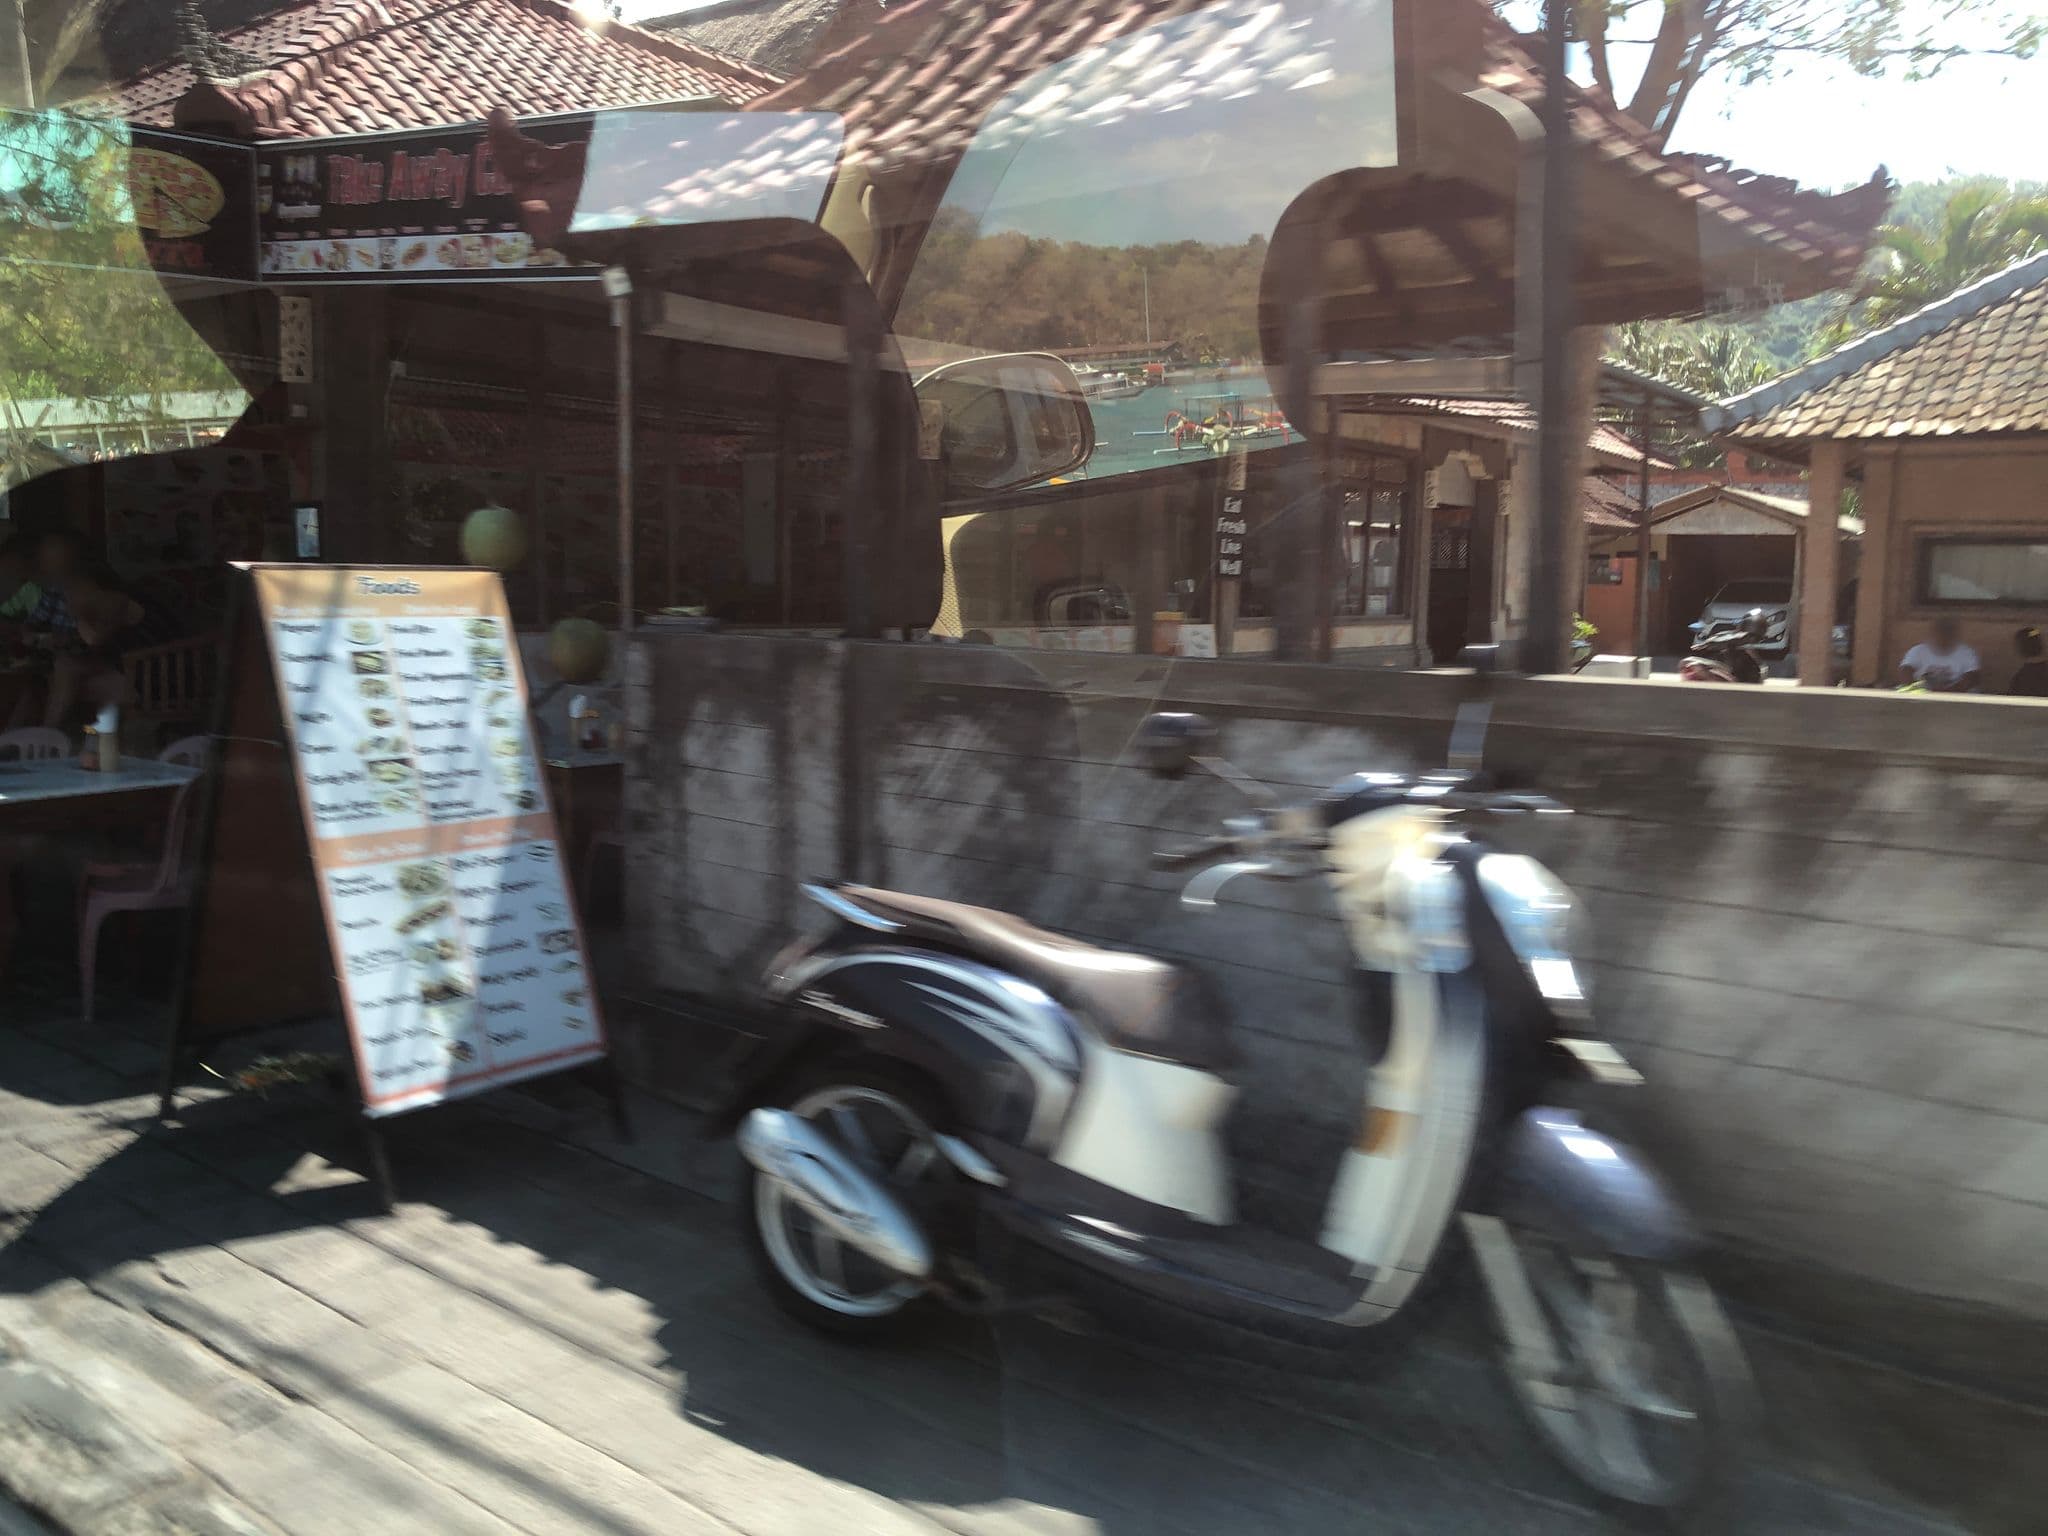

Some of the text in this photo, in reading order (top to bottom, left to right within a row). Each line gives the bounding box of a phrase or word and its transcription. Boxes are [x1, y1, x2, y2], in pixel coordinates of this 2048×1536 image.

[327, 153, 384, 205] Take
[387, 148, 472, 208] Away
[1223, 496, 1242, 513] Eat
[1216, 517, 1247, 534] Fresh
[1220, 559, 1242, 575] Well
[354, 574, 422, 596] Foods
